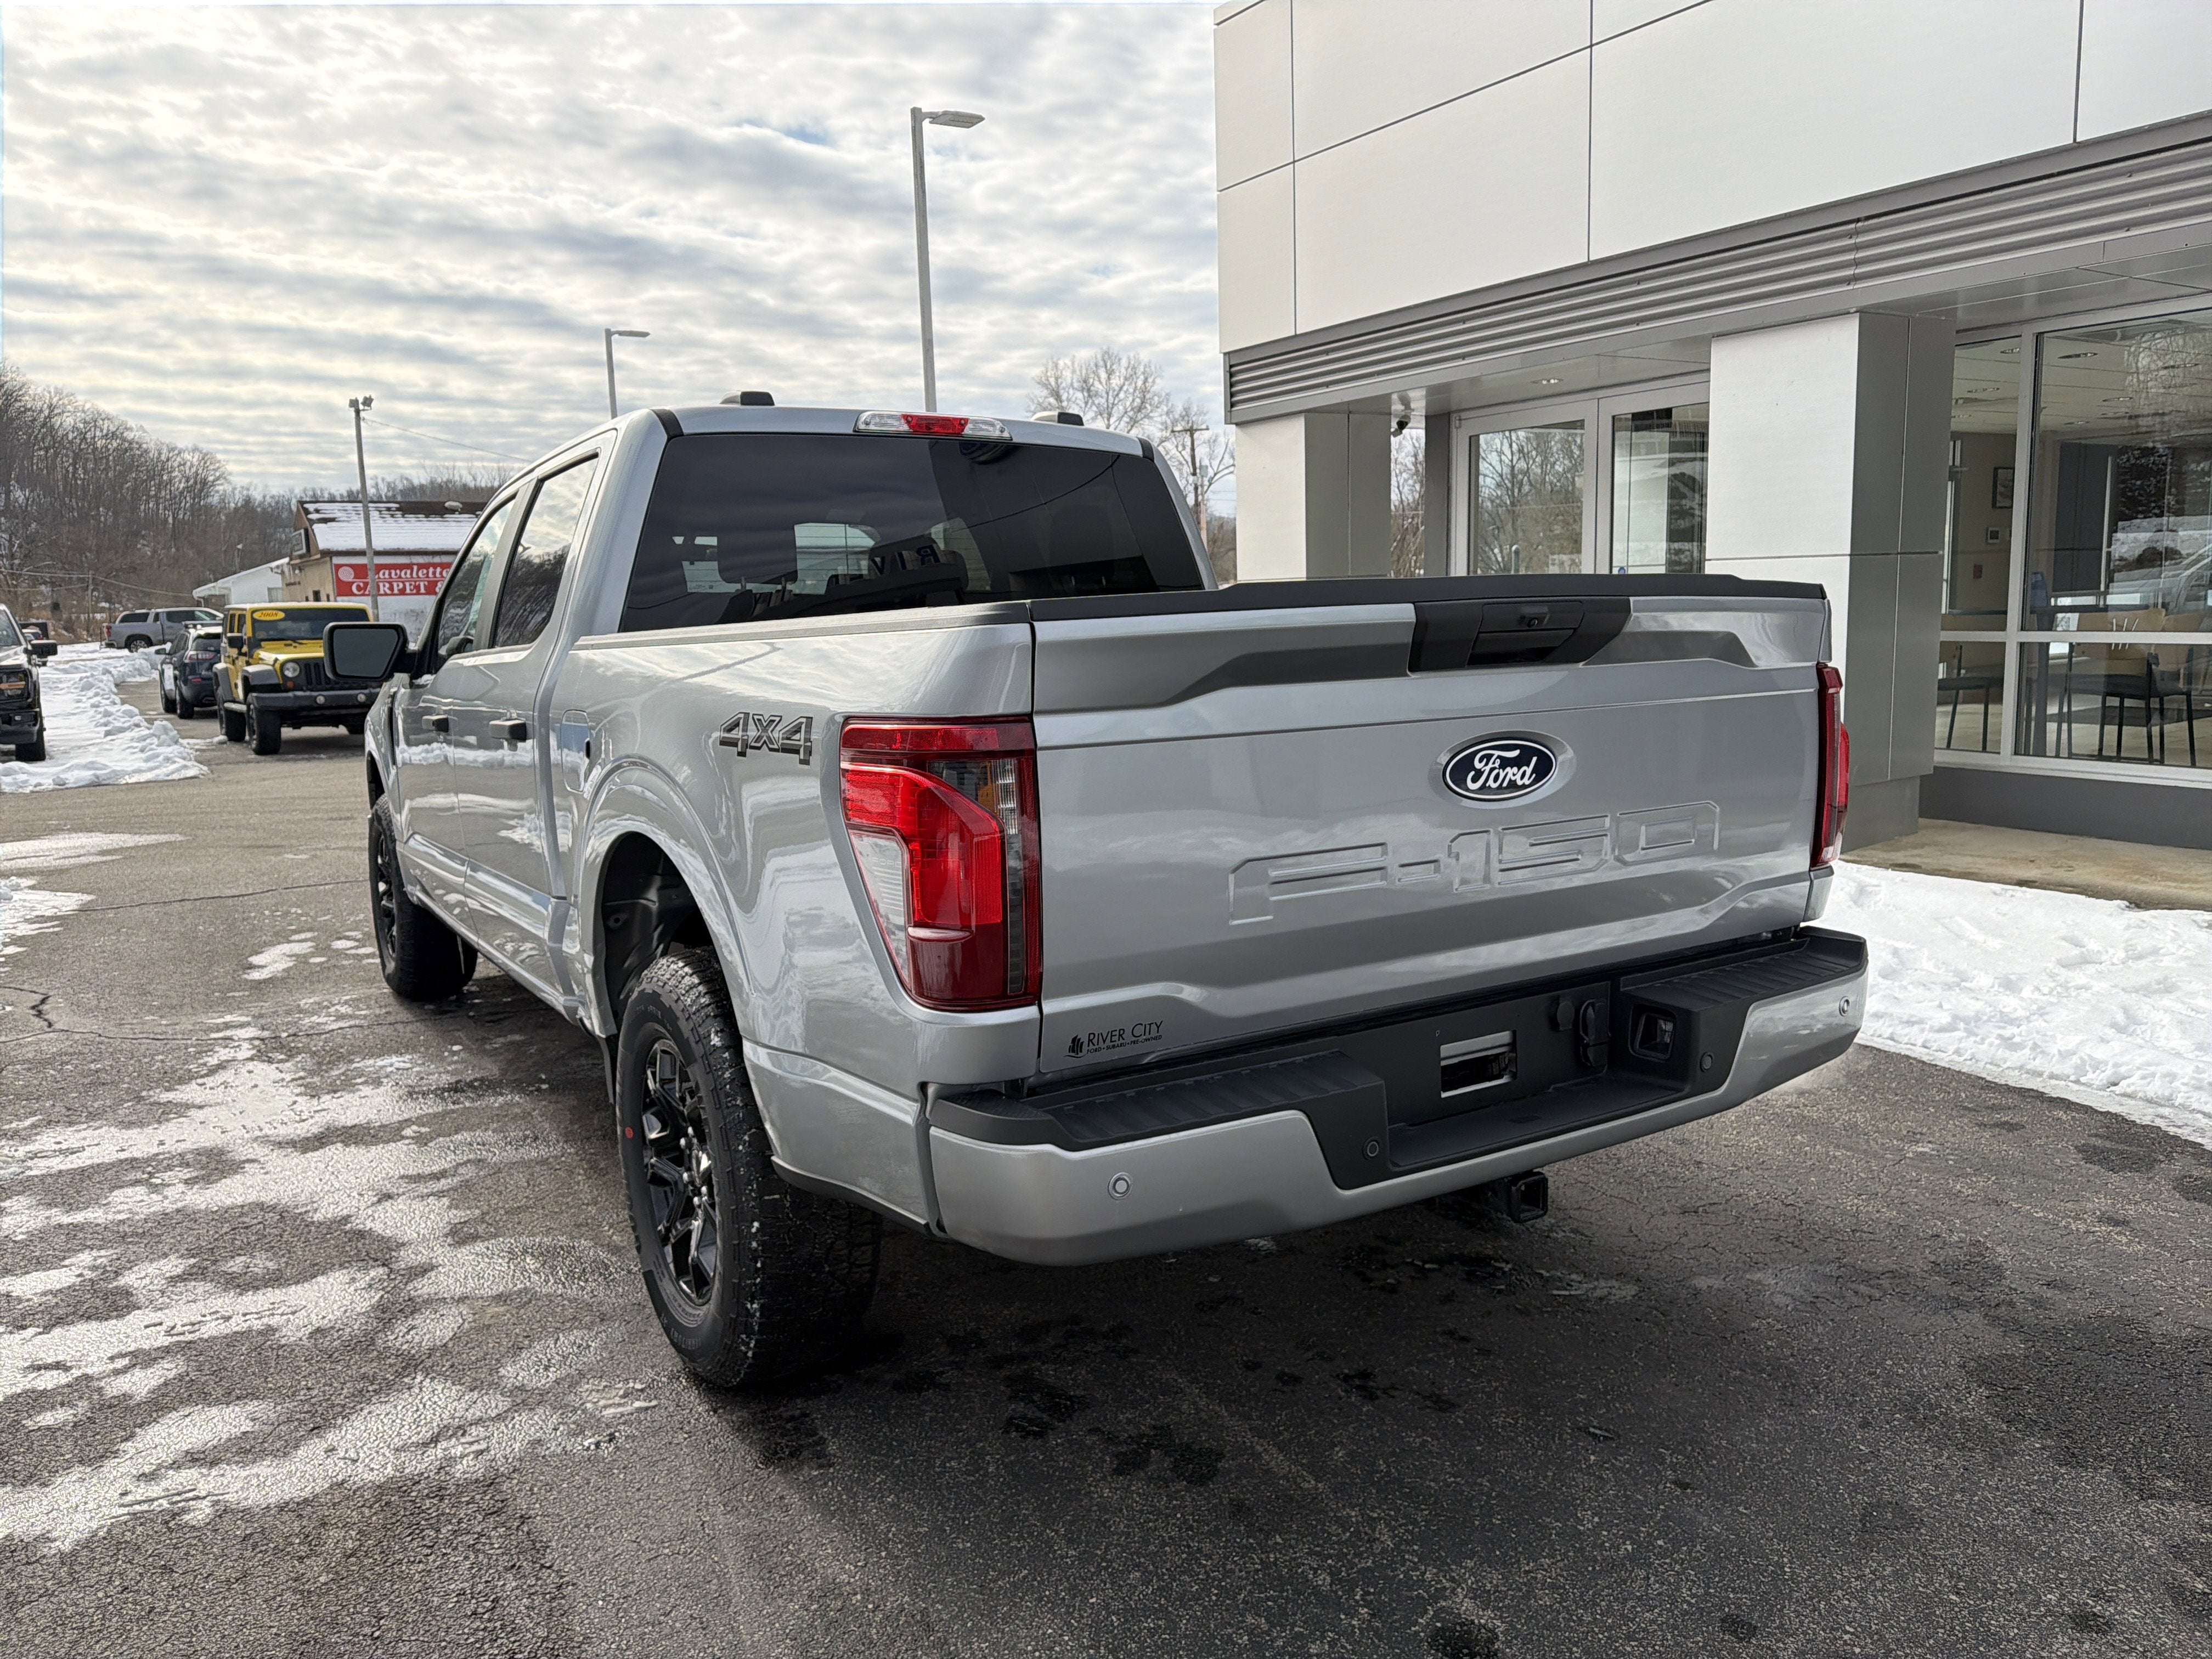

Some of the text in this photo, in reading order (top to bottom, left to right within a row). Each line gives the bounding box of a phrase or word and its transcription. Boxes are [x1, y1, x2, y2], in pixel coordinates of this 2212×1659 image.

[1466, 749, 1538, 790] Ford
[1228, 800, 1720, 925] F-150
[1087, 1020, 1164, 1047] RIVER CITY
[1105, 1042, 1127, 1050] SUBARU
[1130, 1035, 1163, 1045] PRE-OWNED
